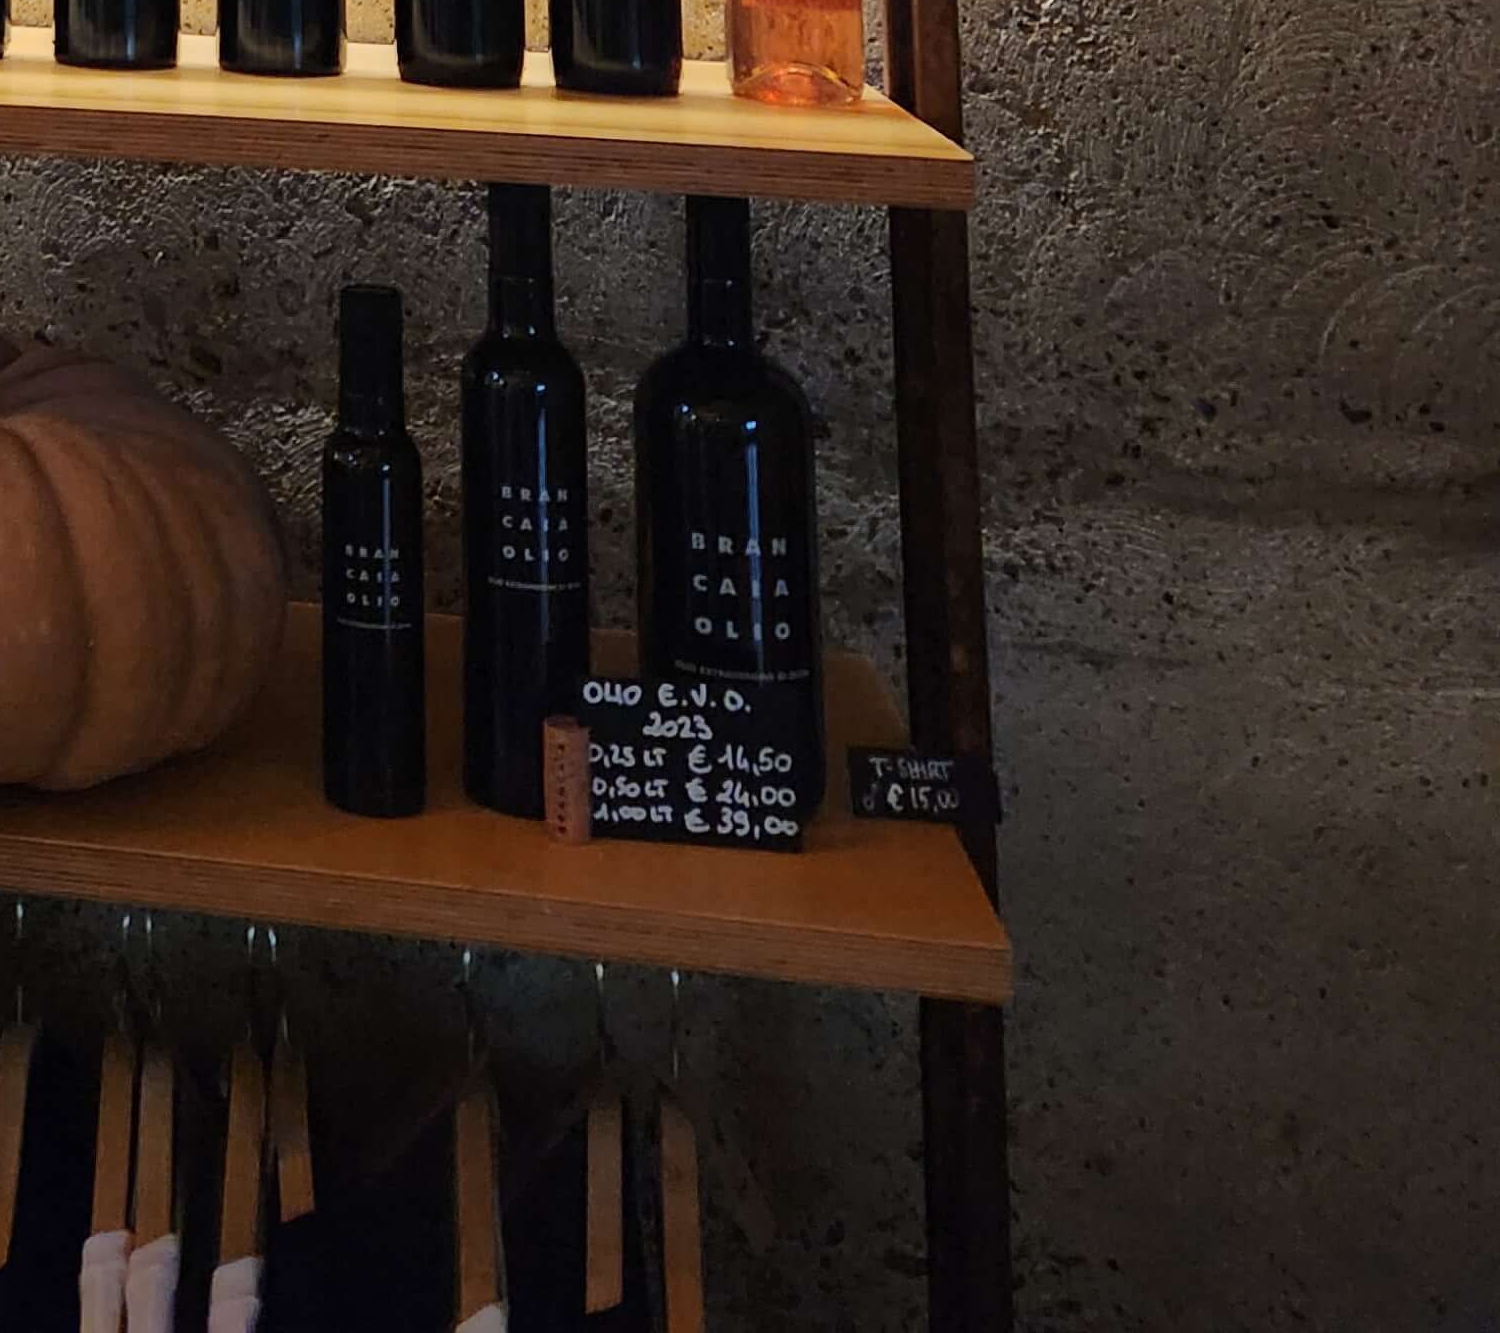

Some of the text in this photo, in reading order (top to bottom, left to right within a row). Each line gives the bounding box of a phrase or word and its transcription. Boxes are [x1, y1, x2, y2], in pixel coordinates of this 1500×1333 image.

[501, 485, 570, 502] BRAN
[501, 514, 569, 532] CAIA
[344, 544, 400, 559] BRAN
[502, 544, 570, 562] OLIO
[691, 531, 788, 557] BRAN
[345, 568, 400, 583] CAIA
[691, 573, 789, 598] CAIA
[346, 592, 400, 607] OLIO
[693, 616, 791, 641] OLIO
[642, 711, 714, 741] 2023
[643, 747, 668, 767] LT
[687, 743, 713, 774] €
[717, 743, 793, 777] 14,50
[644, 778, 669, 799] LT
[684, 777, 708, 803] €
[716, 779, 797, 809] 24,00
[650, 804, 674, 823] LT
[683, 807, 711, 833] €
[716, 807, 799, 841] 39,00
